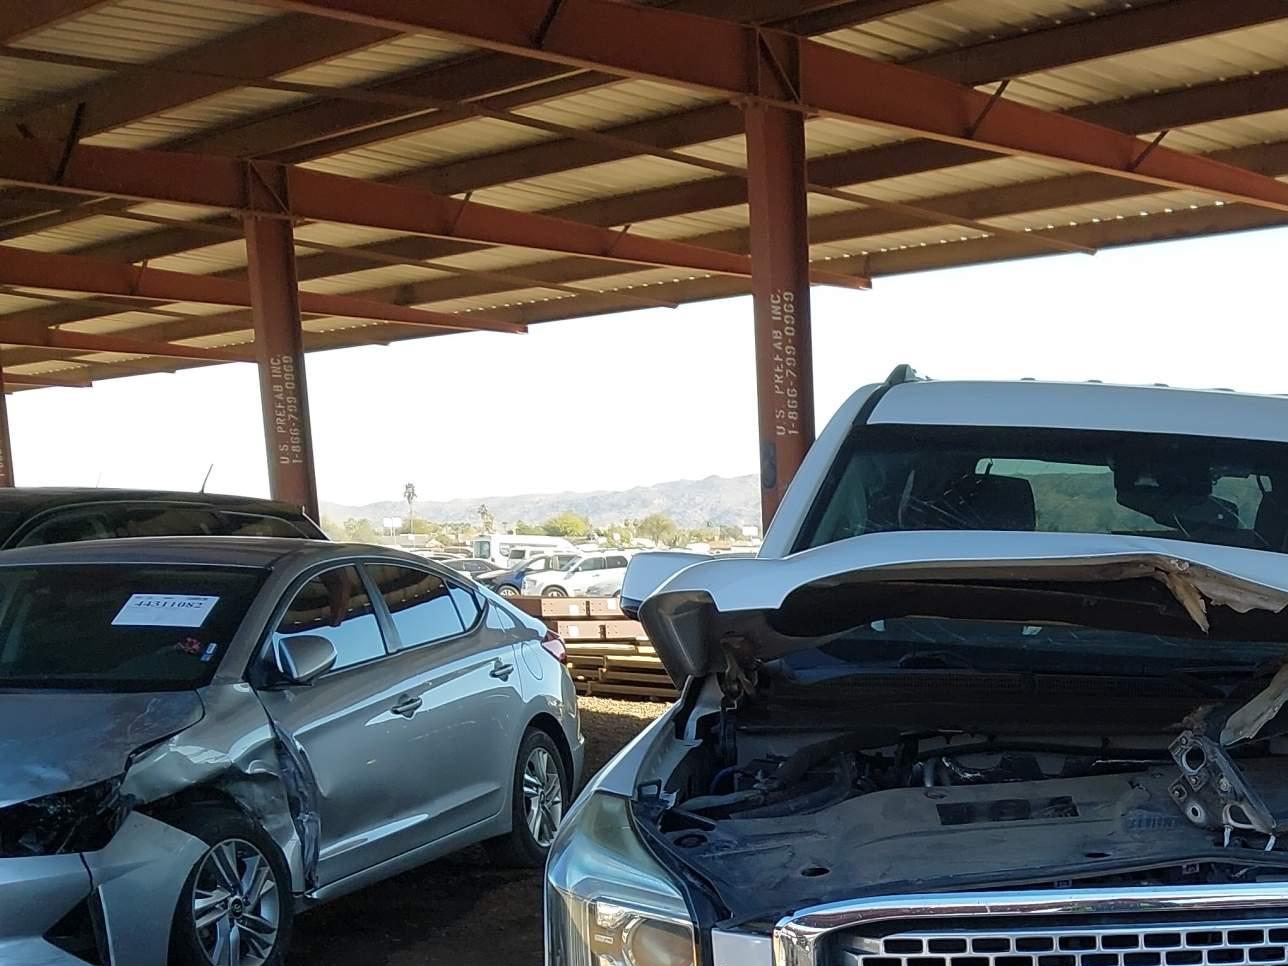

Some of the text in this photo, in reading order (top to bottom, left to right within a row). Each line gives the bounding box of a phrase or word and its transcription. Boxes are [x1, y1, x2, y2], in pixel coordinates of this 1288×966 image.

[771, 329, 785, 395] PREFAB
[783, 291, 799, 435] 1-866-799-0969
[272, 384, 287, 433] PREFAB
